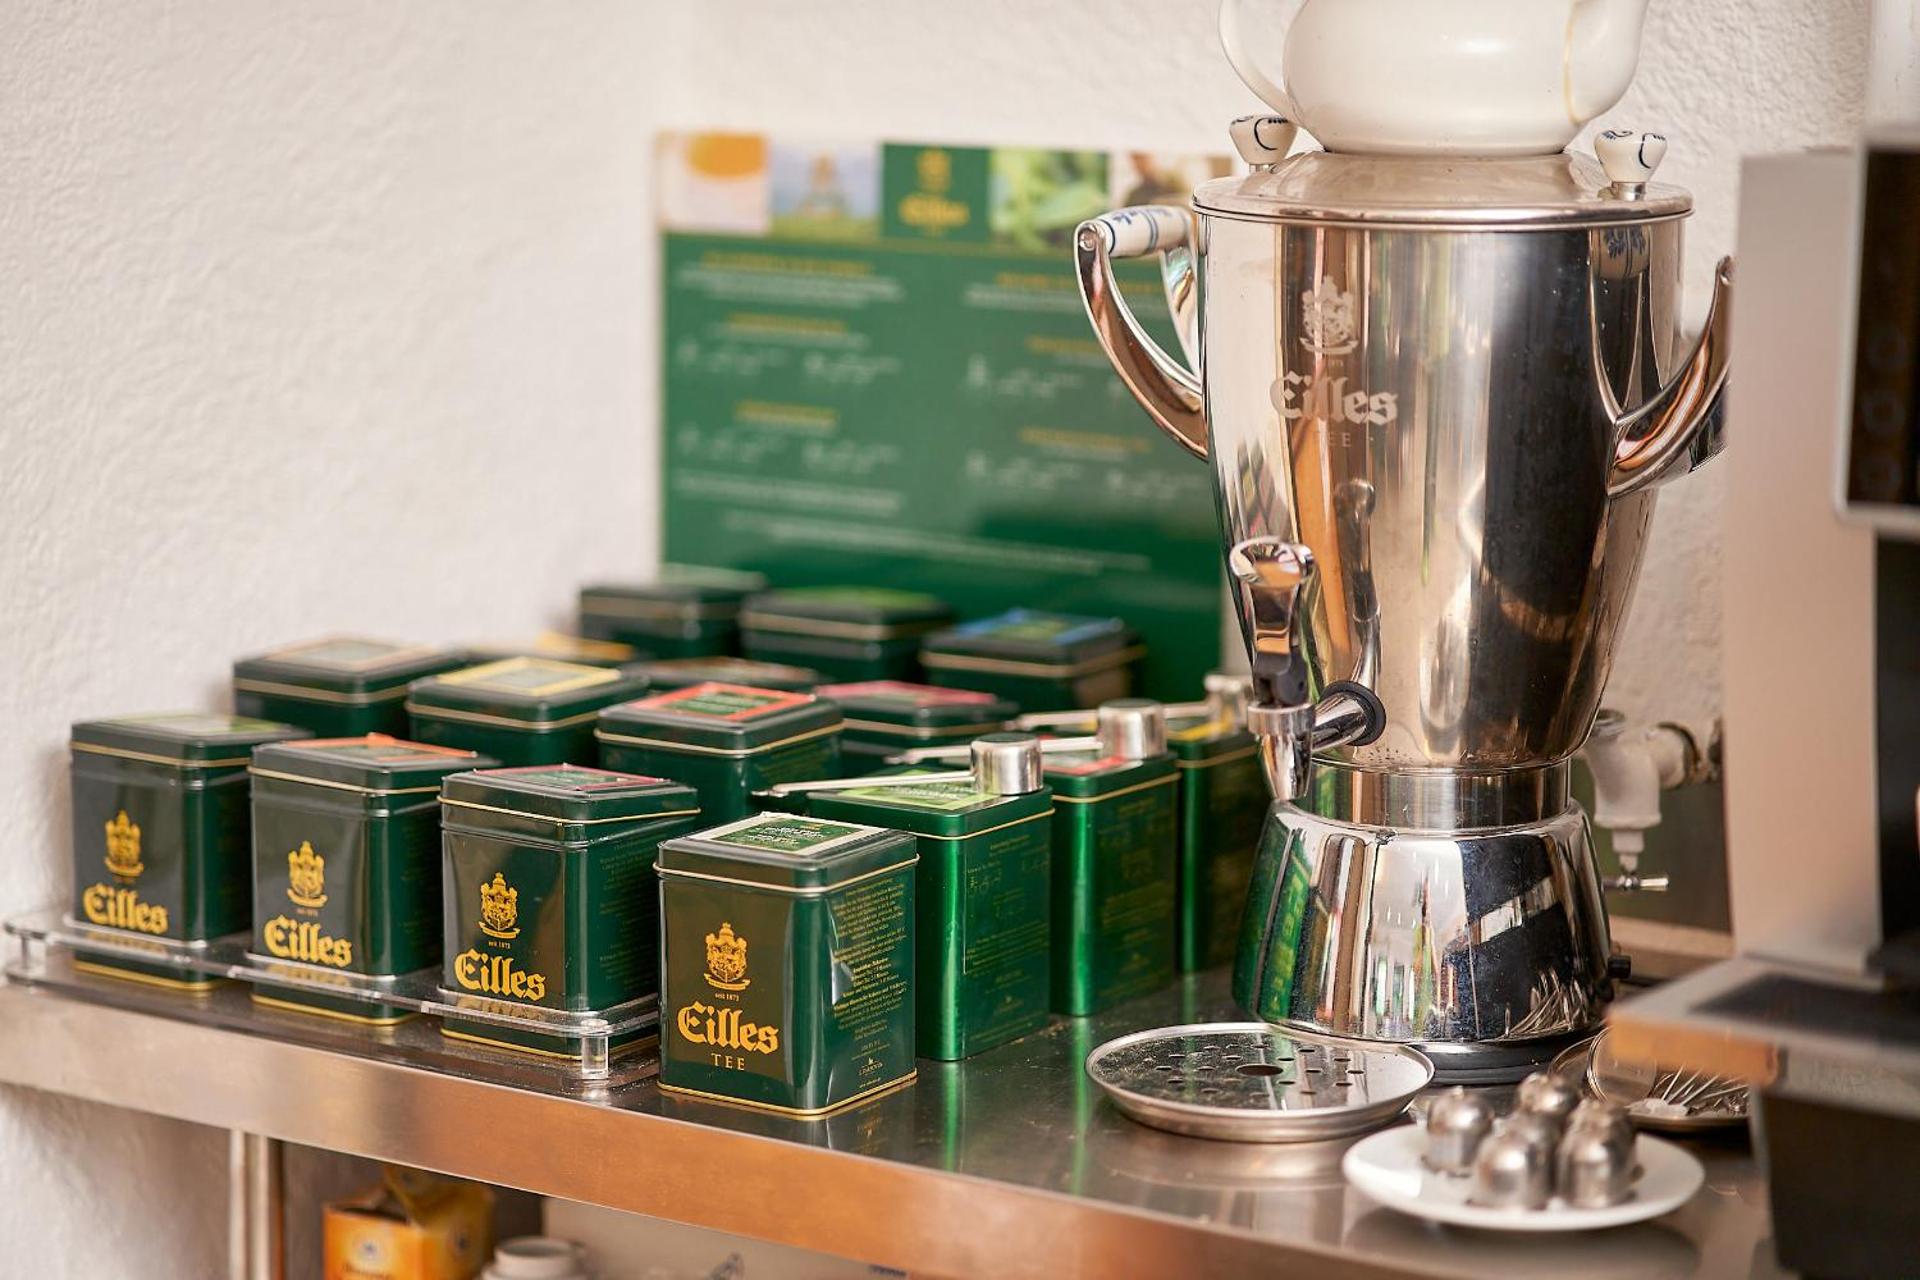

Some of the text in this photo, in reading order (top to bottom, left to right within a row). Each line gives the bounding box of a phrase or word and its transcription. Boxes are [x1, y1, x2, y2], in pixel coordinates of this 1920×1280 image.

[1269, 370, 1398, 426] Eilles
[83, 883, 169, 935] Eilles
[264, 914, 352, 968] Eilles
[454, 948, 546, 1001] Eilles
[677, 1001, 780, 1055] Eilles
[711, 1052, 745, 1071] TEE
